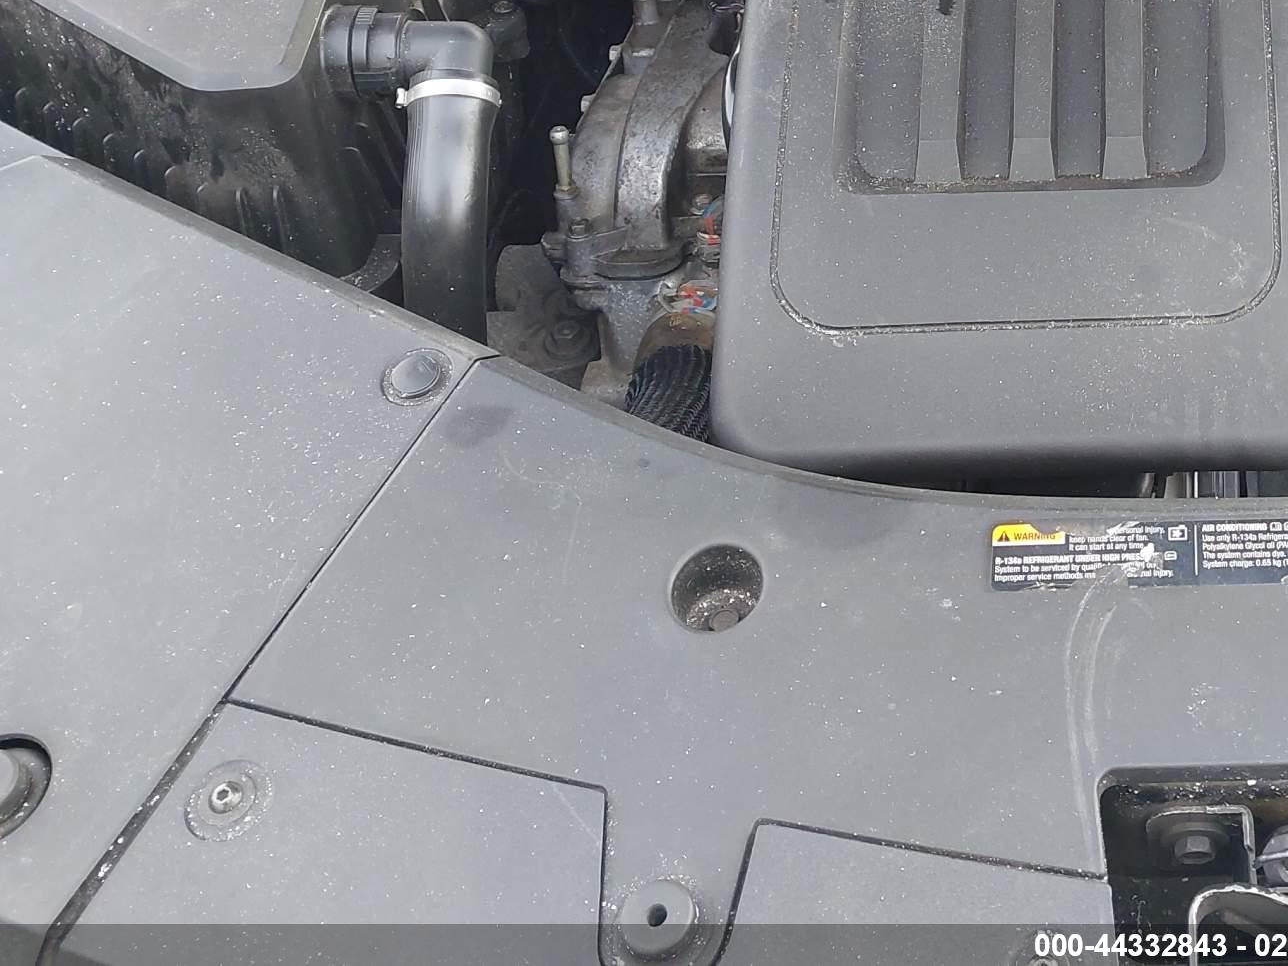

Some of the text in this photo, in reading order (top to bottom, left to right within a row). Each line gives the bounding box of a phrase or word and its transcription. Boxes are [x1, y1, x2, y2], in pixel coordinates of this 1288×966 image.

[1202, 522, 1267, 532] AIR CONDITIONING
[1068, 536, 1085, 545] keep
[1127, 534, 1135, 542] of
[1202, 534, 1215, 542] Use
[1216, 534, 1230, 543] only
[1231, 533, 1257, 541] R-134a
[1068, 543, 1074, 551] It
[1088, 543, 1105, 551] start
[1106, 542, 1114, 550] at
[1114, 542, 1128, 551] any
[1202, 542, 1244, 552] Polyalkylene
[1244, 541, 1265, 550] Glycol
[1266, 541, 1275, 549] oil
[995, 556, 1022, 565] R-134a
[1023, 554, 1074, 564] REFRIGERANT
[1074, 553, 1100, 563] UNDER
[1101, 553, 1120, 562] HIGH
[1203, 549, 1287, 561] The system contains dye.
[995, 565, 1021, 575] System
[1021, 565, 1030, 573] to
[1030, 564, 1040, 573] be
[1040, 564, 1070, 573] serviced
[1071, 563, 1080, 572] by
[1202, 560, 1228, 569] System
[1255, 558, 1271, 567] 0.65
[1272, 558, 1282, 567] kg
[994, 573, 1025, 583] Improper
[1027, 572, 1053, 581] service
[1053, 571, 1084, 580] methods
